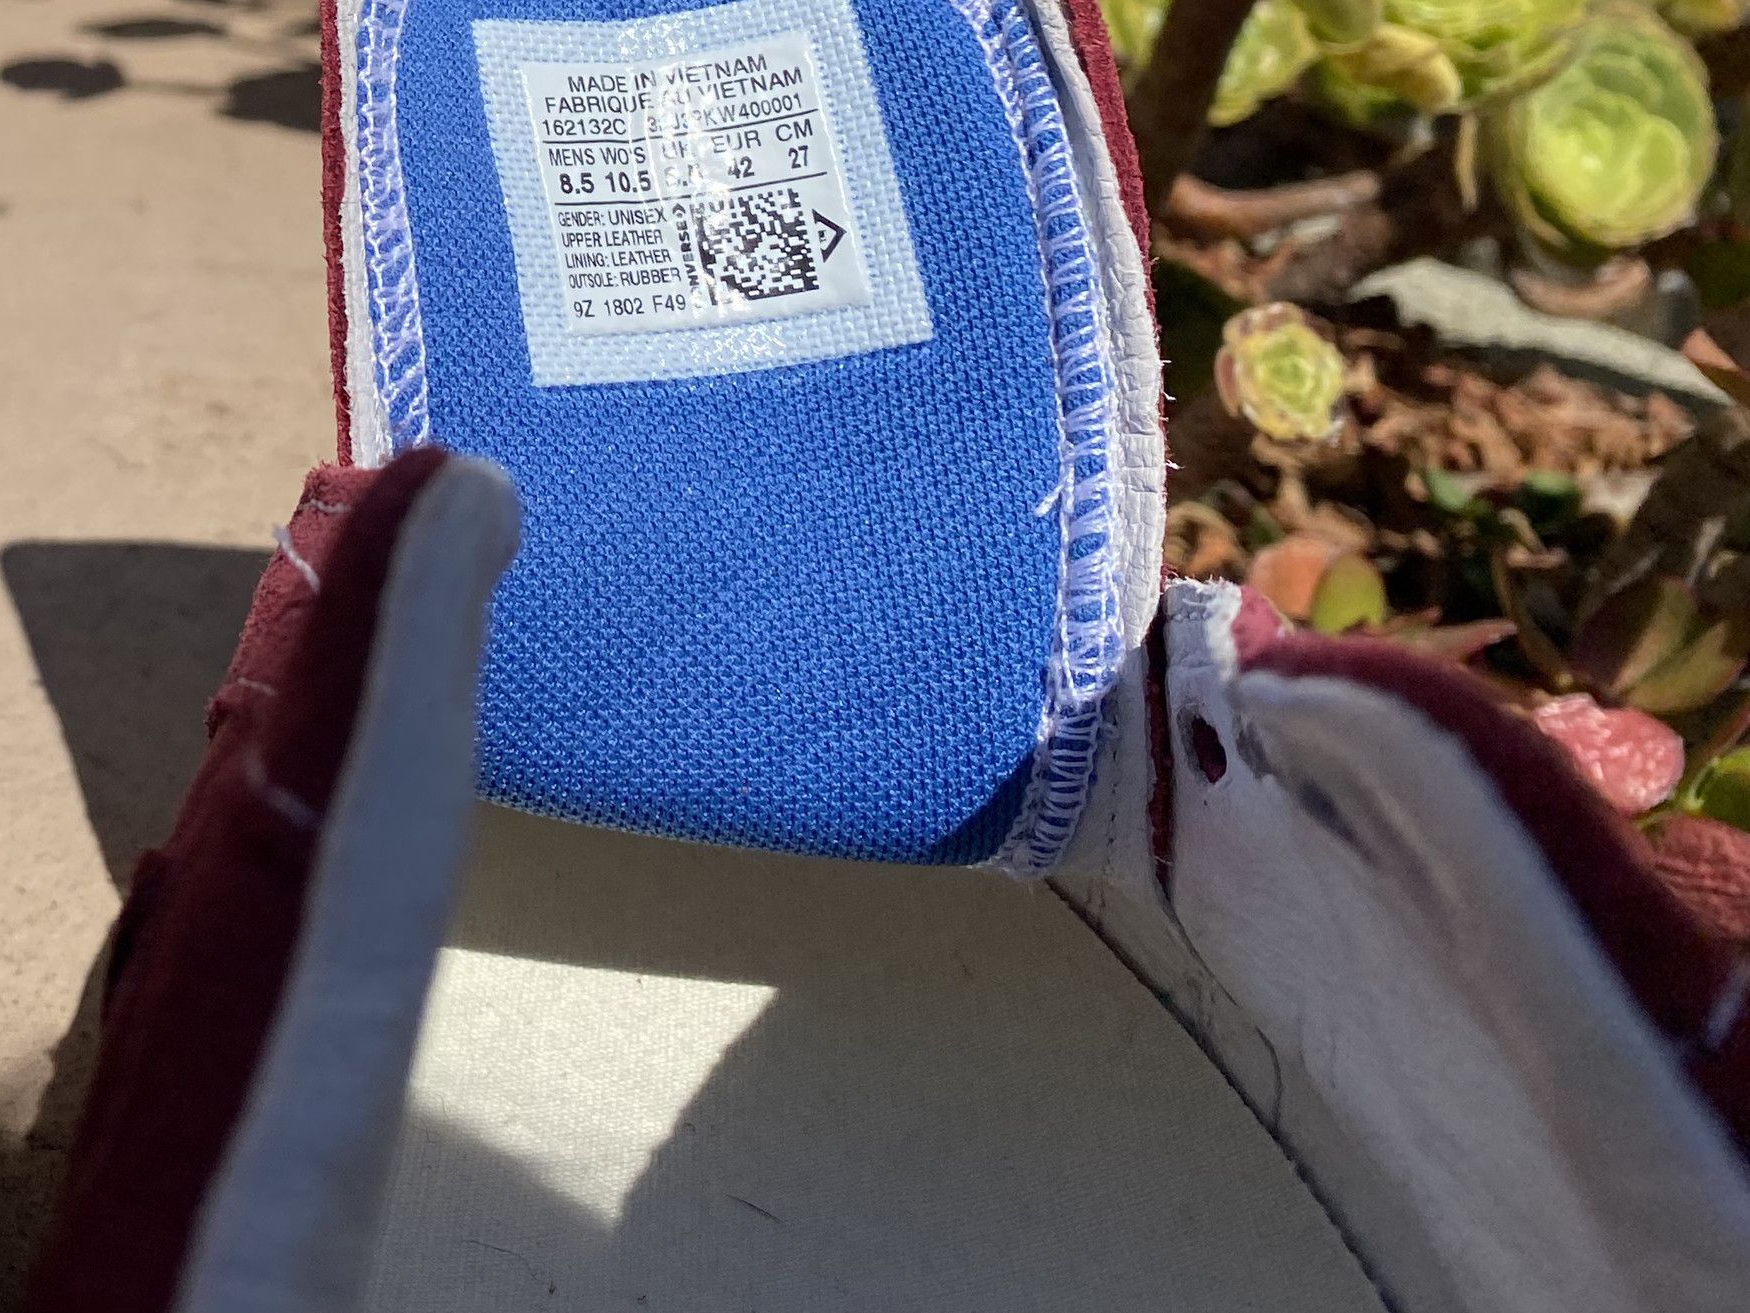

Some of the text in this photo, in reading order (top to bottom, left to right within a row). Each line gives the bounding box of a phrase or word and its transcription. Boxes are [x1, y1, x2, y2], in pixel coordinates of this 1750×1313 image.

[545, 91, 652, 114] FABRIQUE
[697, 67, 803, 101] VIETNAM
[567, 54, 768, 93] MADE IN VIETNAM
[542, 93, 802, 136] 162132C 3JPKW400001
[549, 147, 595, 166] MENS
[600, 146, 646, 165] WO'S
[713, 131, 762, 154] EUR
[775, 118, 813, 142] CM
[559, 173, 594, 194] 8.5
[606, 170, 651, 192] 10.5
[728, 157, 755, 179] 42
[788, 145, 809, 169] 27
[558, 208, 668, 226] GENDER: UNISEX
[606, 229, 662, 247] LEATHER
[565, 249, 672, 269] LINING: LEATHER
[569, 267, 681, 289] OUTSOLE: RUBBER
[676, 220, 704, 309] NVERSE
[573, 294, 686, 318] 9Z 1802 F49
